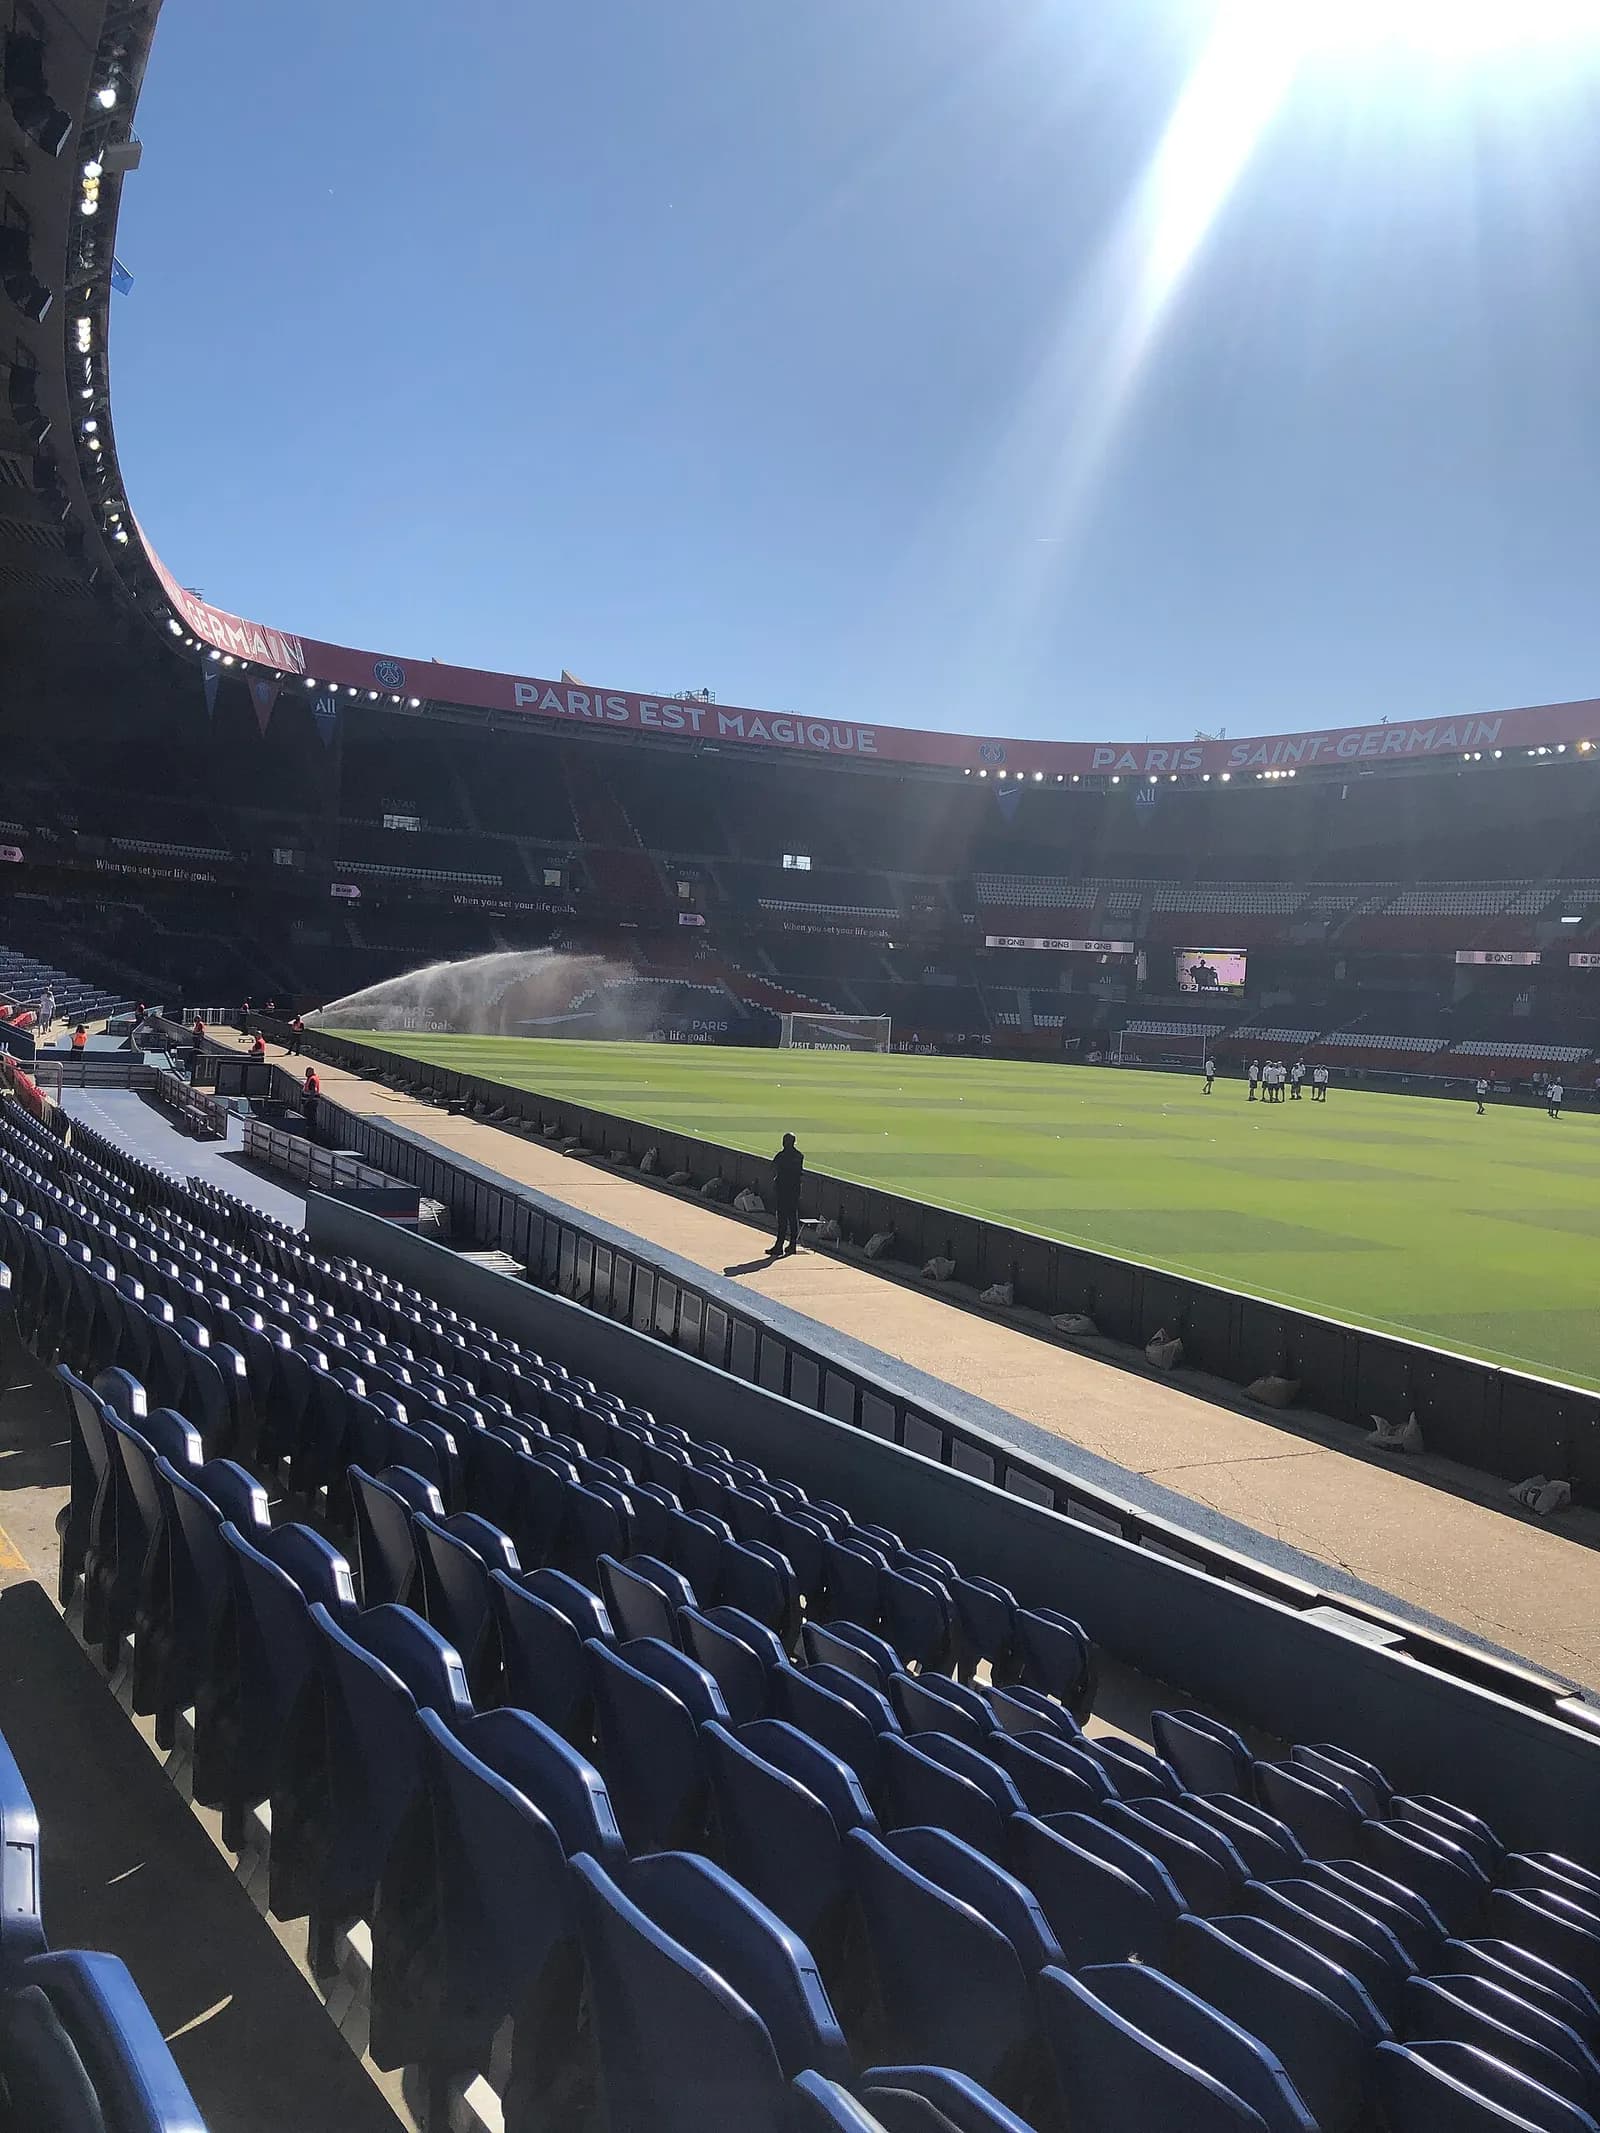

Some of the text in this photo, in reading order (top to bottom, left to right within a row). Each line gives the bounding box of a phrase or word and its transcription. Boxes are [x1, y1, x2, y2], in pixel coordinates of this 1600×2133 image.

[185, 599, 307, 675] GERMAIN
[514, 682, 878, 753] PARIS EST MAGIQUE
[1092, 717, 1503, 771] PARIS SAINT-GERMAIN
[96, 859, 120, 871] When
[122, 864, 136, 874] you
[139, 867, 150, 875] set
[152, 868, 173, 878] your
[173, 868, 189, 879] life
[453, 895, 479, 905] When
[481, 899, 498, 907] you
[500, 900, 512, 908] set
[514, 902, 534, 910] your
[536, 903, 551, 912] life
[783, 921, 806, 931] When
[807, 925, 821, 933] you
[836, 927, 854, 936] your
[854, 927, 868, 936] life
[1007, 938, 1112, 951] QNB QNB QNB
[693, 1020, 728, 1032] PARIS
[669, 1031, 686, 1041] life
[789, 1041, 851, 1051] VISIT RWANDA
